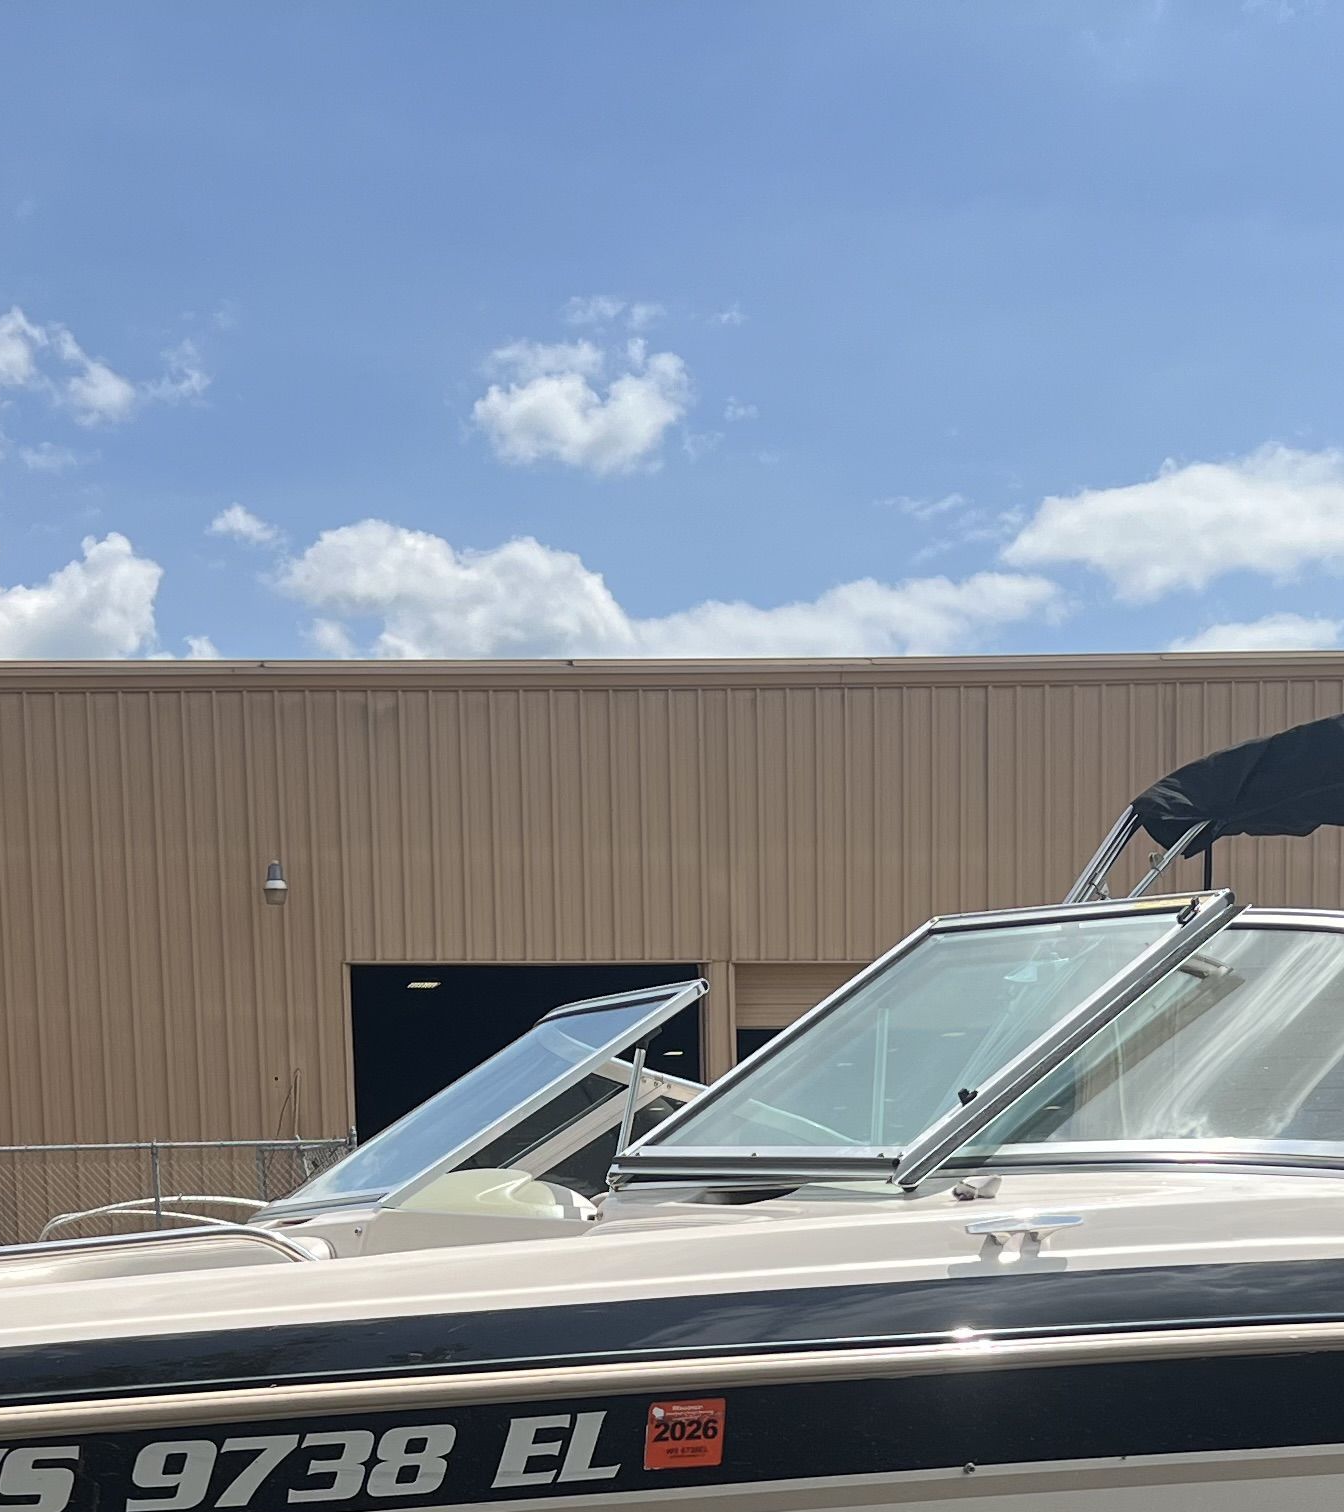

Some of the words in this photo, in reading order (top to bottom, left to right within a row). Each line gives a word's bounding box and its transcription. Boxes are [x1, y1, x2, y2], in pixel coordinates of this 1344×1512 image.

[125, 1424, 456, 1512] 9738
[490, 1410, 622, 1489] EL
[653, 1419, 718, 1443] 2026
